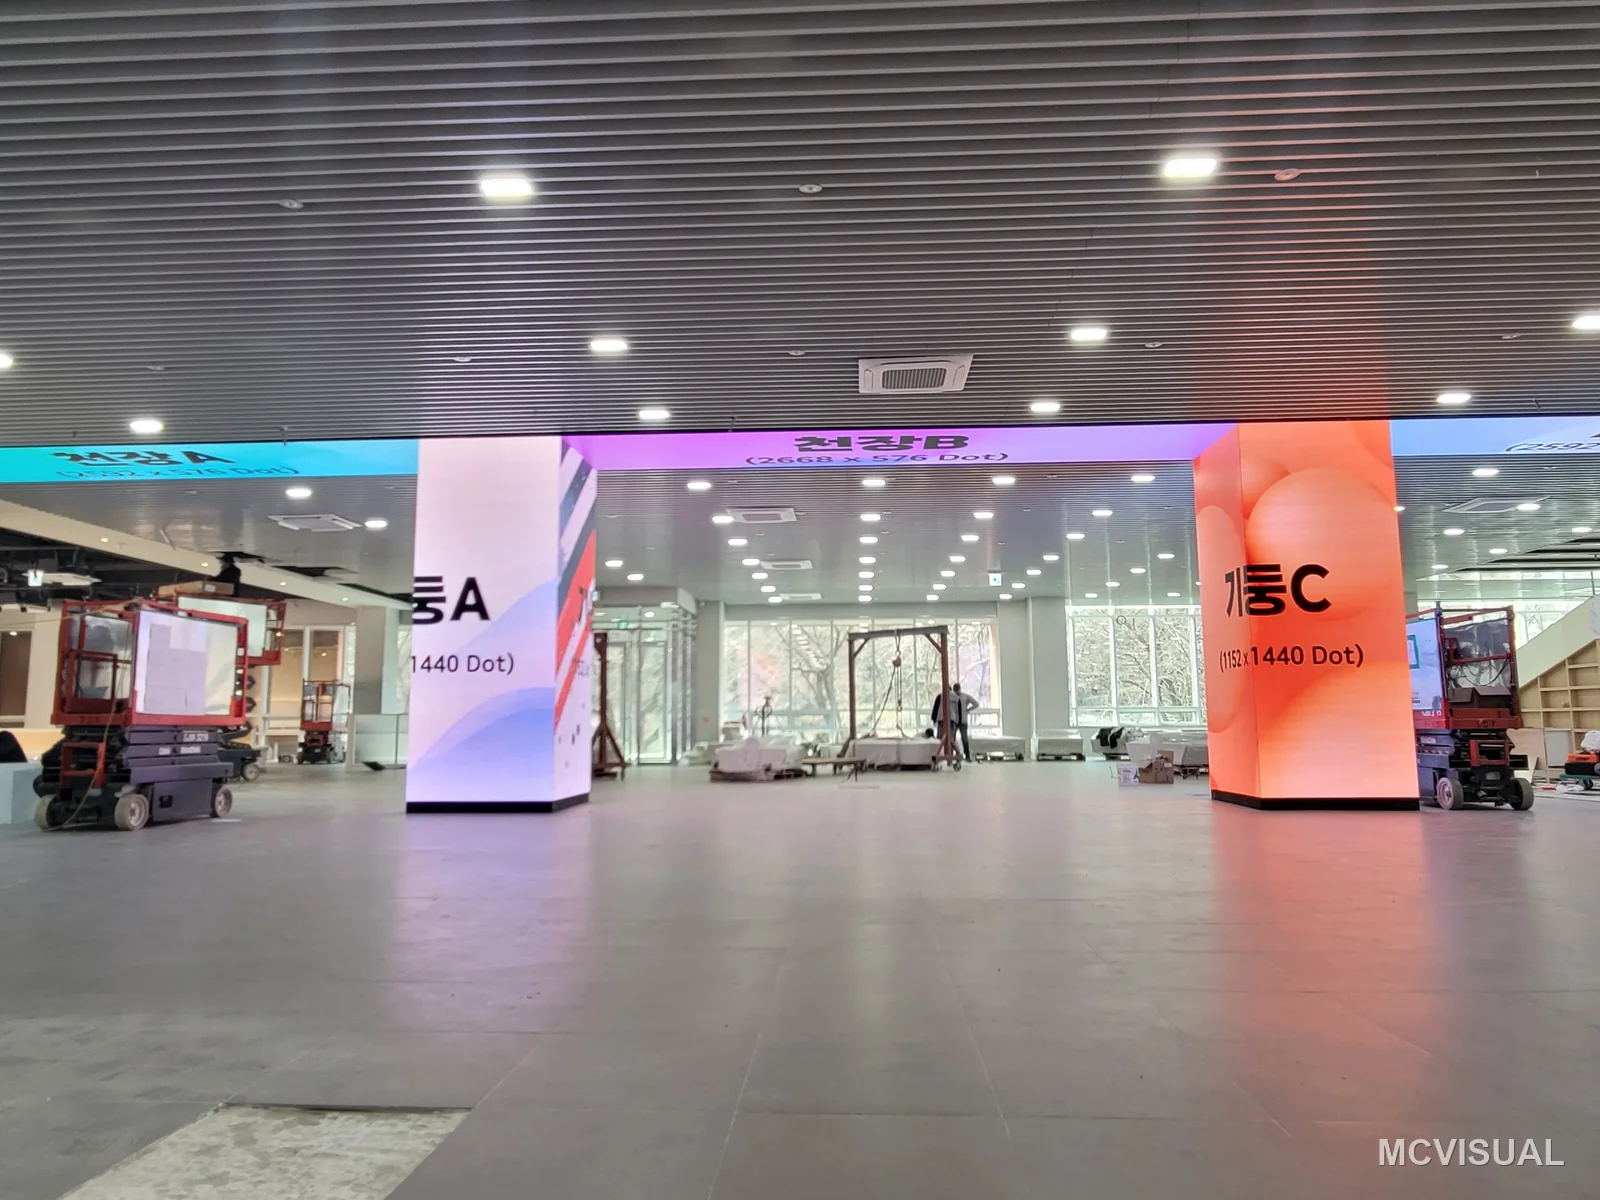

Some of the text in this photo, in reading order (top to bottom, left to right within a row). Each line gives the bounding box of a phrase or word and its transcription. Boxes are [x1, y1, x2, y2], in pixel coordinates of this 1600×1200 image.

[794, 435, 970, 452] 천장B
[745, 456, 834, 465] (2668
[872, 454, 928, 463] 576
[938, 452, 1009, 462] Dot)
[1224, 564, 1332, 618] 기둥C
[411, 652, 515, 676] 1440 Dot)
[1219, 648, 1242, 673] (1152
[1250, 646, 1304, 666] 1440
[1311, 643, 1364, 668] Dot)
